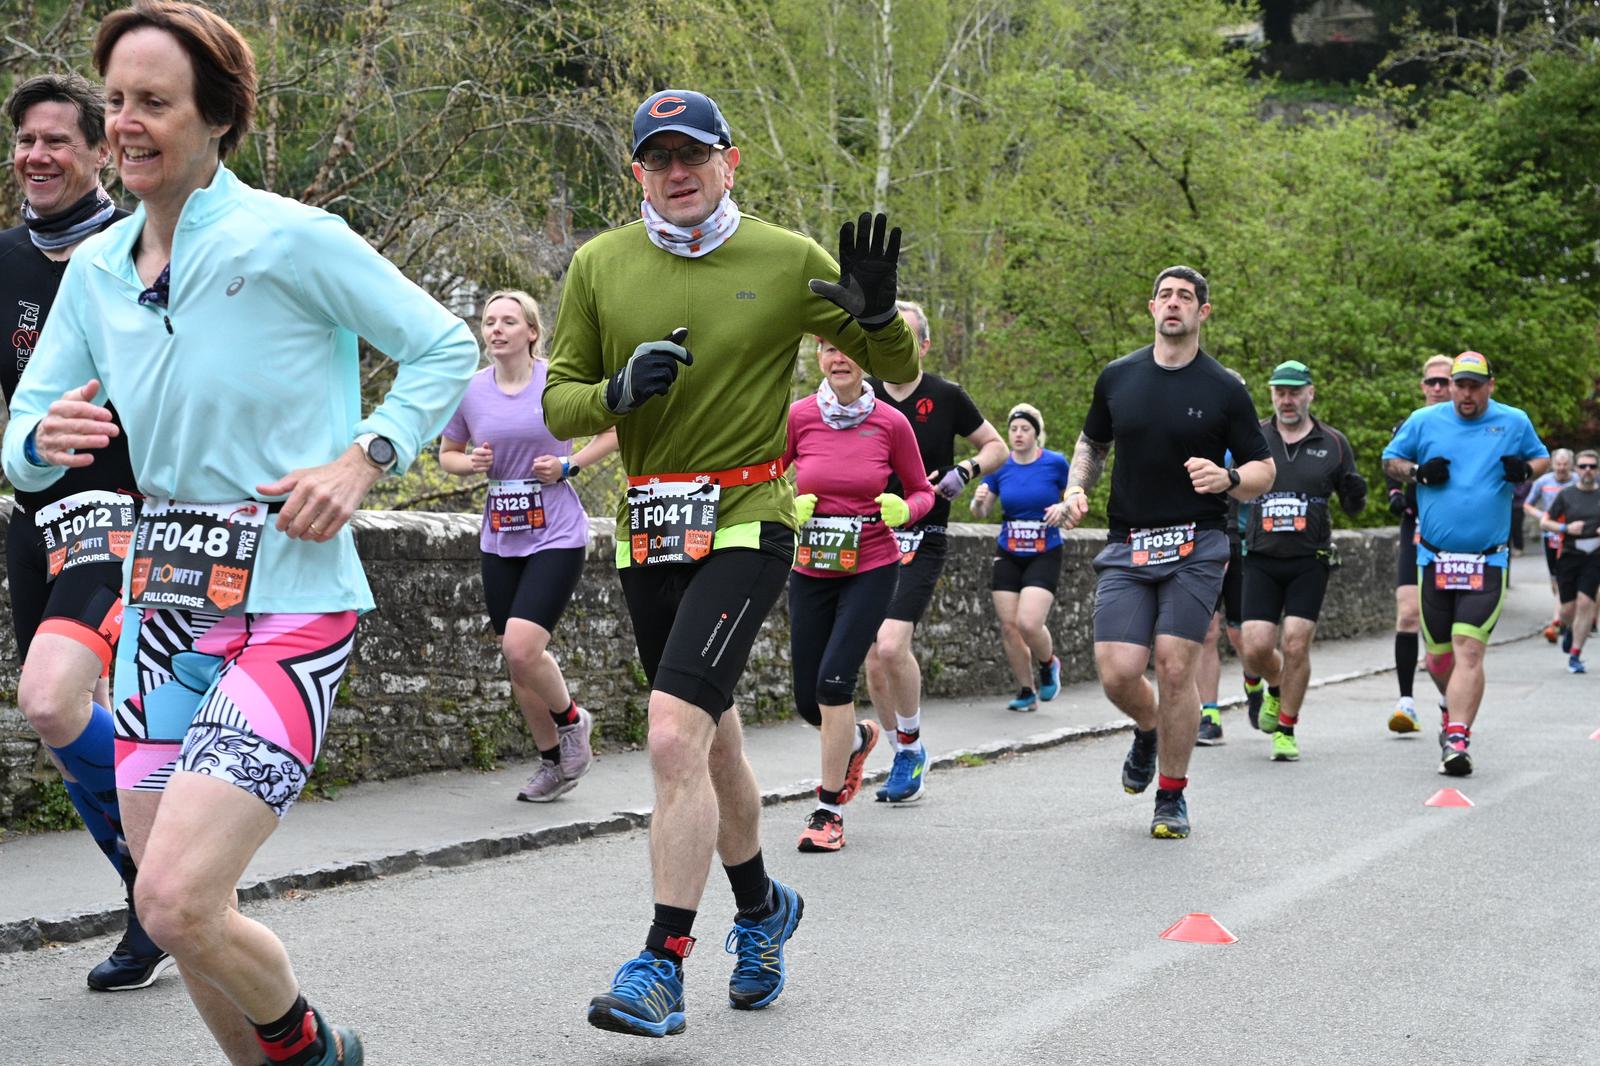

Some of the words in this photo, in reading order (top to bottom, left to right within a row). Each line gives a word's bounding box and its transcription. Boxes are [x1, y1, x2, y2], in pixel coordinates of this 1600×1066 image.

[736, 290, 757, 300] dhb
[496, 496, 530, 511] S128
[1268, 505, 1300, 517] F004
[125, 507, 133, 526] FULL
[643, 504, 693, 529] F041
[706, 505, 715, 525] FULL
[58, 507, 113, 543] F012
[147, 521, 231, 558] F048
[243, 530, 257, 560] FULL
[808, 531, 846, 547] R177
[1143, 531, 1185, 550] F032
[151, 563, 203, 586] FLOWFIT
[215, 570, 244, 581] STORM
